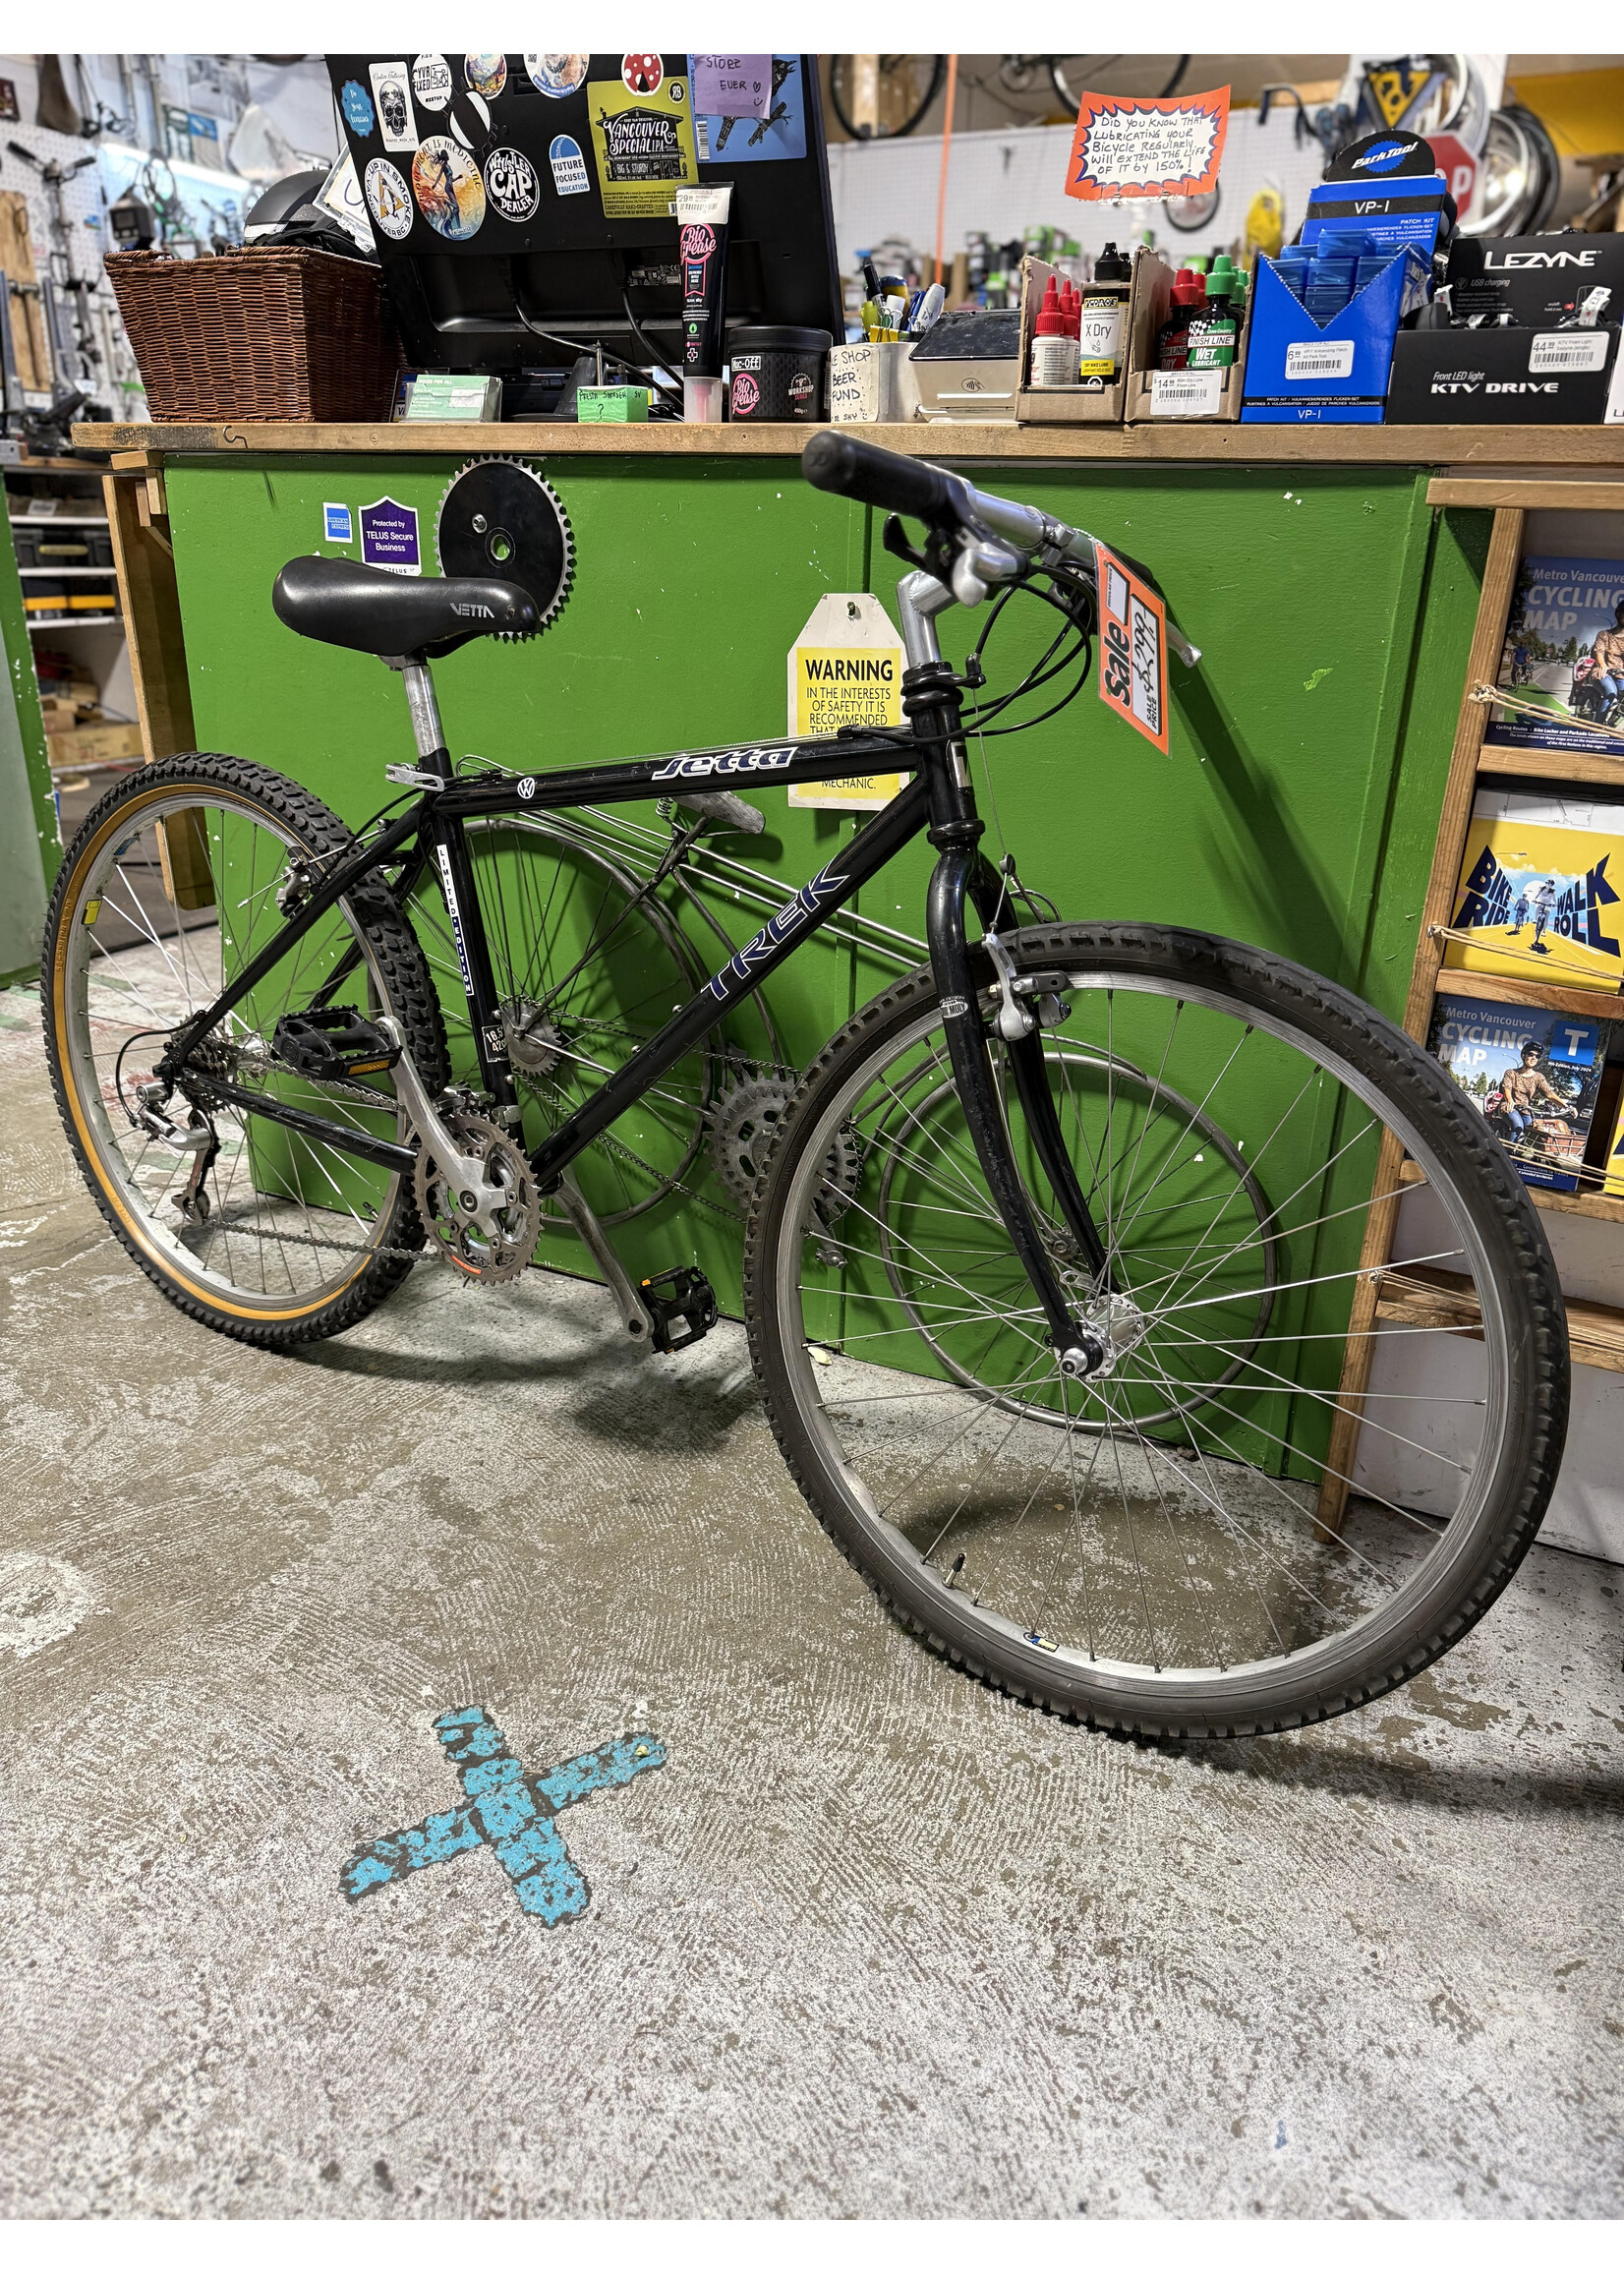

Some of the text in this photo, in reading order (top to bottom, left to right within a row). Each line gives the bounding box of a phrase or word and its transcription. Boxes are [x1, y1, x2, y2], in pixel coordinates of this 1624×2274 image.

[603, 113, 676, 144] VANCOUVER
[609, 138, 651, 155] SPECIAL
[1162, 150, 1180, 159] THE
[552, 159, 584, 172] FUTURE
[1098, 165, 1112, 174] OF
[1119, 163, 1130, 173] IT
[490, 168, 533, 200] CAP
[555, 171, 586, 183] FOCUSED
[558, 182, 588, 193] EDUCATION
[391, 171, 411, 224] SMOKE
[499, 195, 534, 213] DEALER
[686, 226, 706, 244] Bio
[1484, 250, 1597, 270] LEZYNE
[1470, 278, 1511, 287] USB charging
[1085, 323, 1112, 339] X Dry
[1189, 335, 1232, 346] FINISH LINE
[1533, 342, 1546, 352] 44
[841, 349, 871, 365] SHOP
[1195, 347, 1217, 361] WET
[1287, 350, 1295, 361] 6
[833, 372, 857, 386] BEER
[1158, 379, 1168, 388] 14
[1432, 371, 1485, 381] Front LED light
[1430, 382, 1559, 394] KTV DRIVE
[372, 519, 405, 529] Protected by
[366, 530, 414, 541] TELUS Secure
[375, 542, 406, 552] Business
[1533, 568, 1624, 584] Metro Vancouve
[450, 603, 494, 618] VETTA
[1524, 610, 1578, 631] MAP
[805, 659, 893, 681] WARNING
[1102, 620, 1131, 708] Sale
[806, 687, 891, 700] IN THE INTERESTS
[812, 701, 886, 713] OF SAFETY IT IS
[809, 714, 888, 726] RECOMMENDED
[821, 778, 876, 789] MECHANIC.
[1465, 845, 1513, 908] BIKE
[1556, 852, 1621, 916] WALK
[1452, 890, 1510, 929] RIDE
[439, 849, 471, 993] LIMITED EDITION
[700, 858, 850, 1001] TREK
[1554, 907, 1622, 959] ROLL
[949, 1002, 965, 1016] MOLY
[1445, 1007, 1537, 1029] Metro Vancouver
[1442, 1021, 1534, 1051] CYCLING
[1564, 1028, 1590, 1057] T
[1437, 1043, 1487, 1067] MAP
